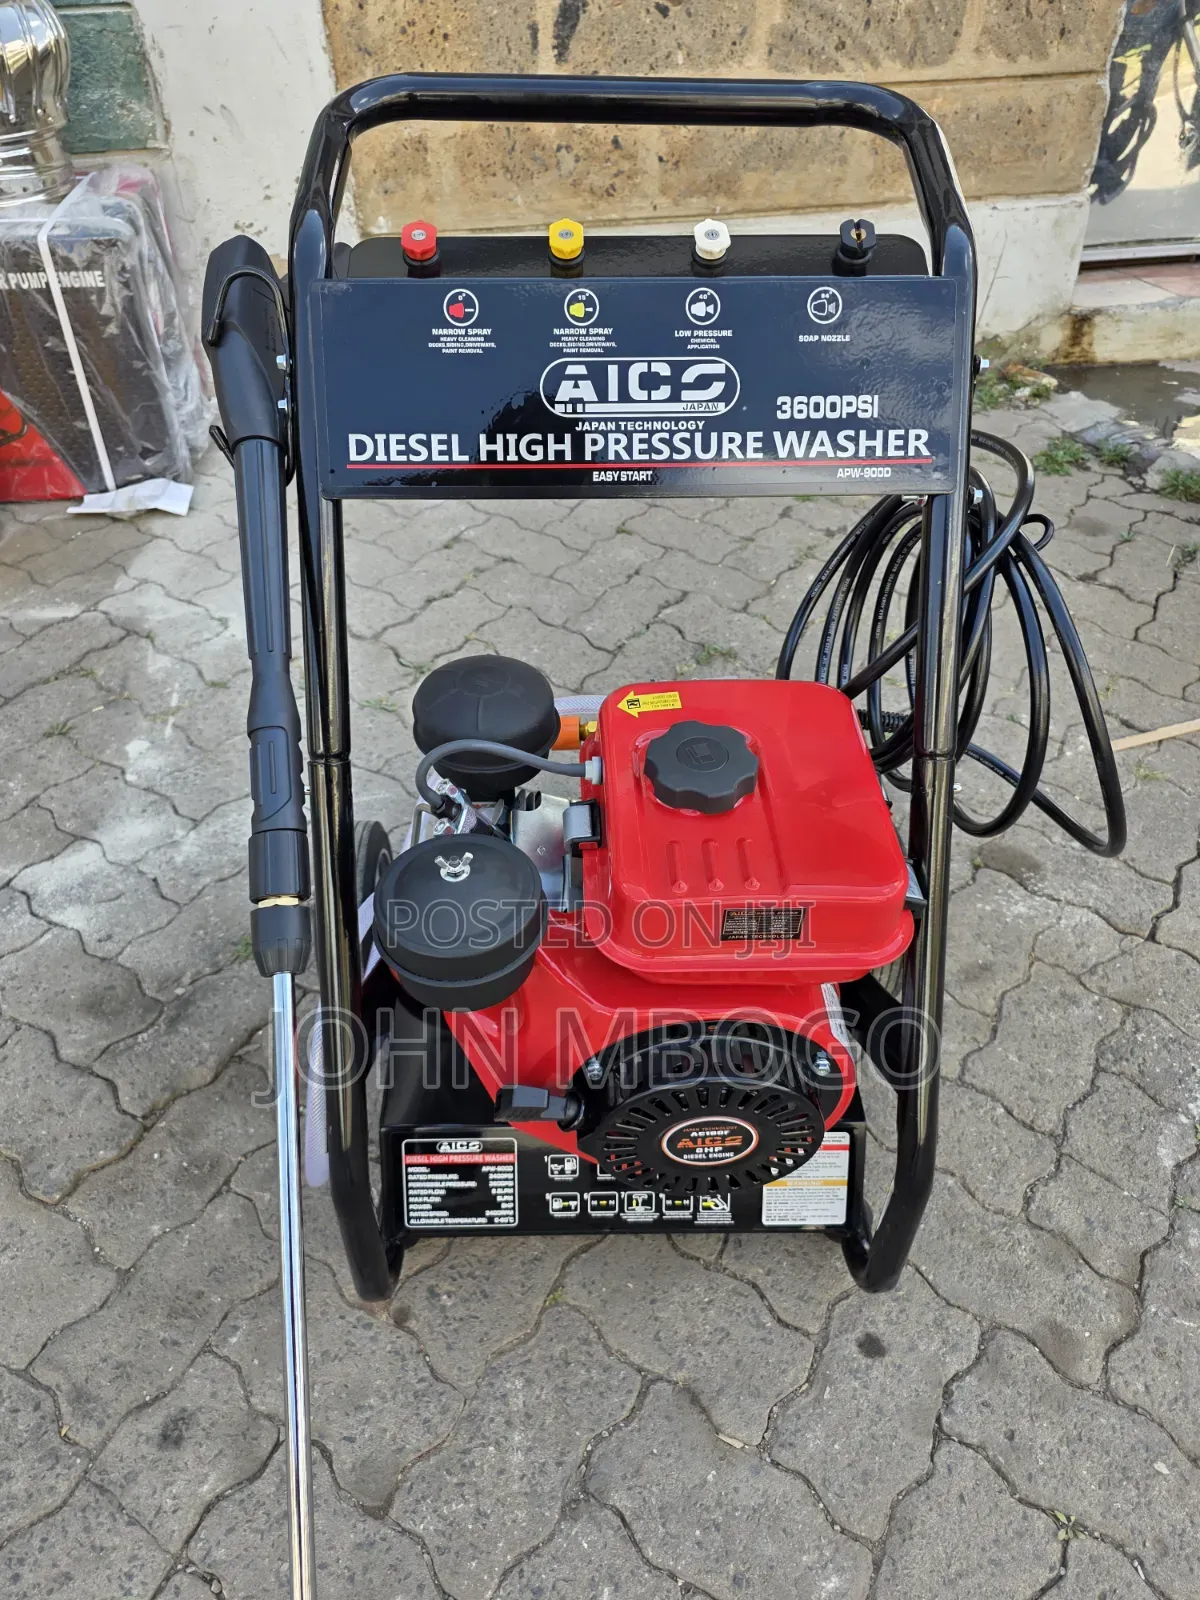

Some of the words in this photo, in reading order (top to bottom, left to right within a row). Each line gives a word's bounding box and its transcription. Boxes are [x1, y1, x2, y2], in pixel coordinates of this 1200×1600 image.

[7, 272, 48, 289] PUMP
[553, 327, 587, 335] NARROW
[588, 327, 613, 335] SPRAY
[693, 329, 733, 337] PRESSURE
[821, 334, 851, 342] NOZZLE
[682, 402, 719, 411] JAPAN
[776, 395, 879, 419] 3600PSI
[575, 421, 616, 431] JAPAN
[618, 420, 706, 431] TECHNOLOGY
[348, 433, 470, 462] DIESEL
[479, 433, 573, 462] HIGH
[584, 431, 764, 461] PRESSURE
[773, 429, 931, 459] WASHER
[593, 471, 619, 482] EASY
[620, 471, 653, 482] START
[837, 467, 891, 479] APW-900D
[406, 1155, 429, 1163] DIESEL
[430, 1155, 448, 1163] HIGH
[450, 1154, 483, 1163] PRESSURE
[484, 1153, 514, 1162] WASHER
[544, 1155, 548, 1163] 1
